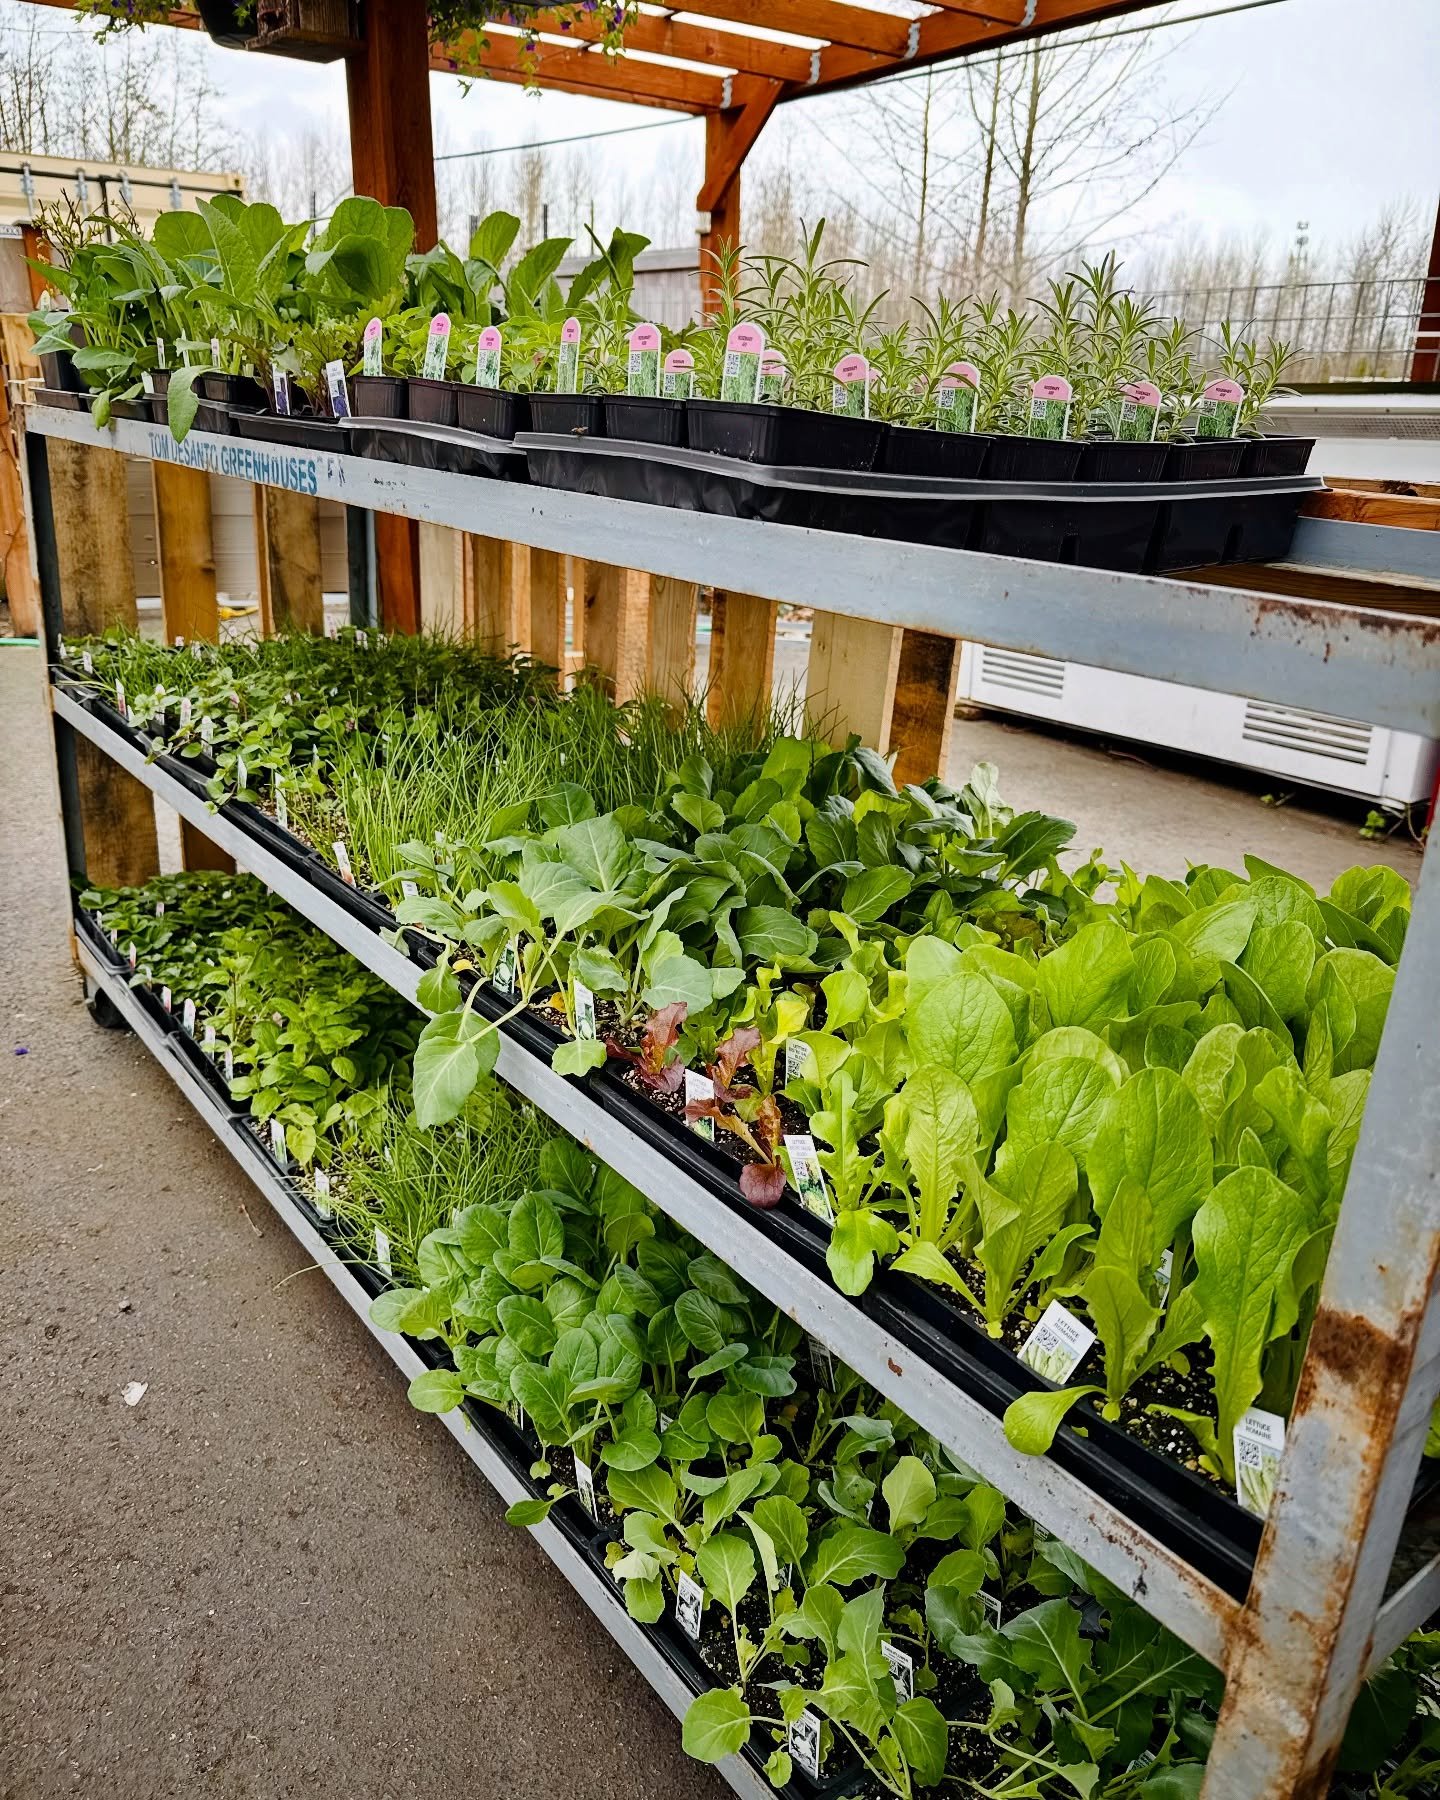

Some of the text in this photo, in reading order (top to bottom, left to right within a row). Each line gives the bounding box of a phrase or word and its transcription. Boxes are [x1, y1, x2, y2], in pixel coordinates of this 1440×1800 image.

[149, 432, 169, 459] TOM
[220, 445, 318, 496] GREENHOUSES
[1053, 1322, 1077, 1344] ROMAINE
[1057, 1317, 1081, 1339] LETTUCE
[1245, 1416, 1271, 1432] LETTUCE
[1245, 1425, 1272, 1440] ROMAINE
